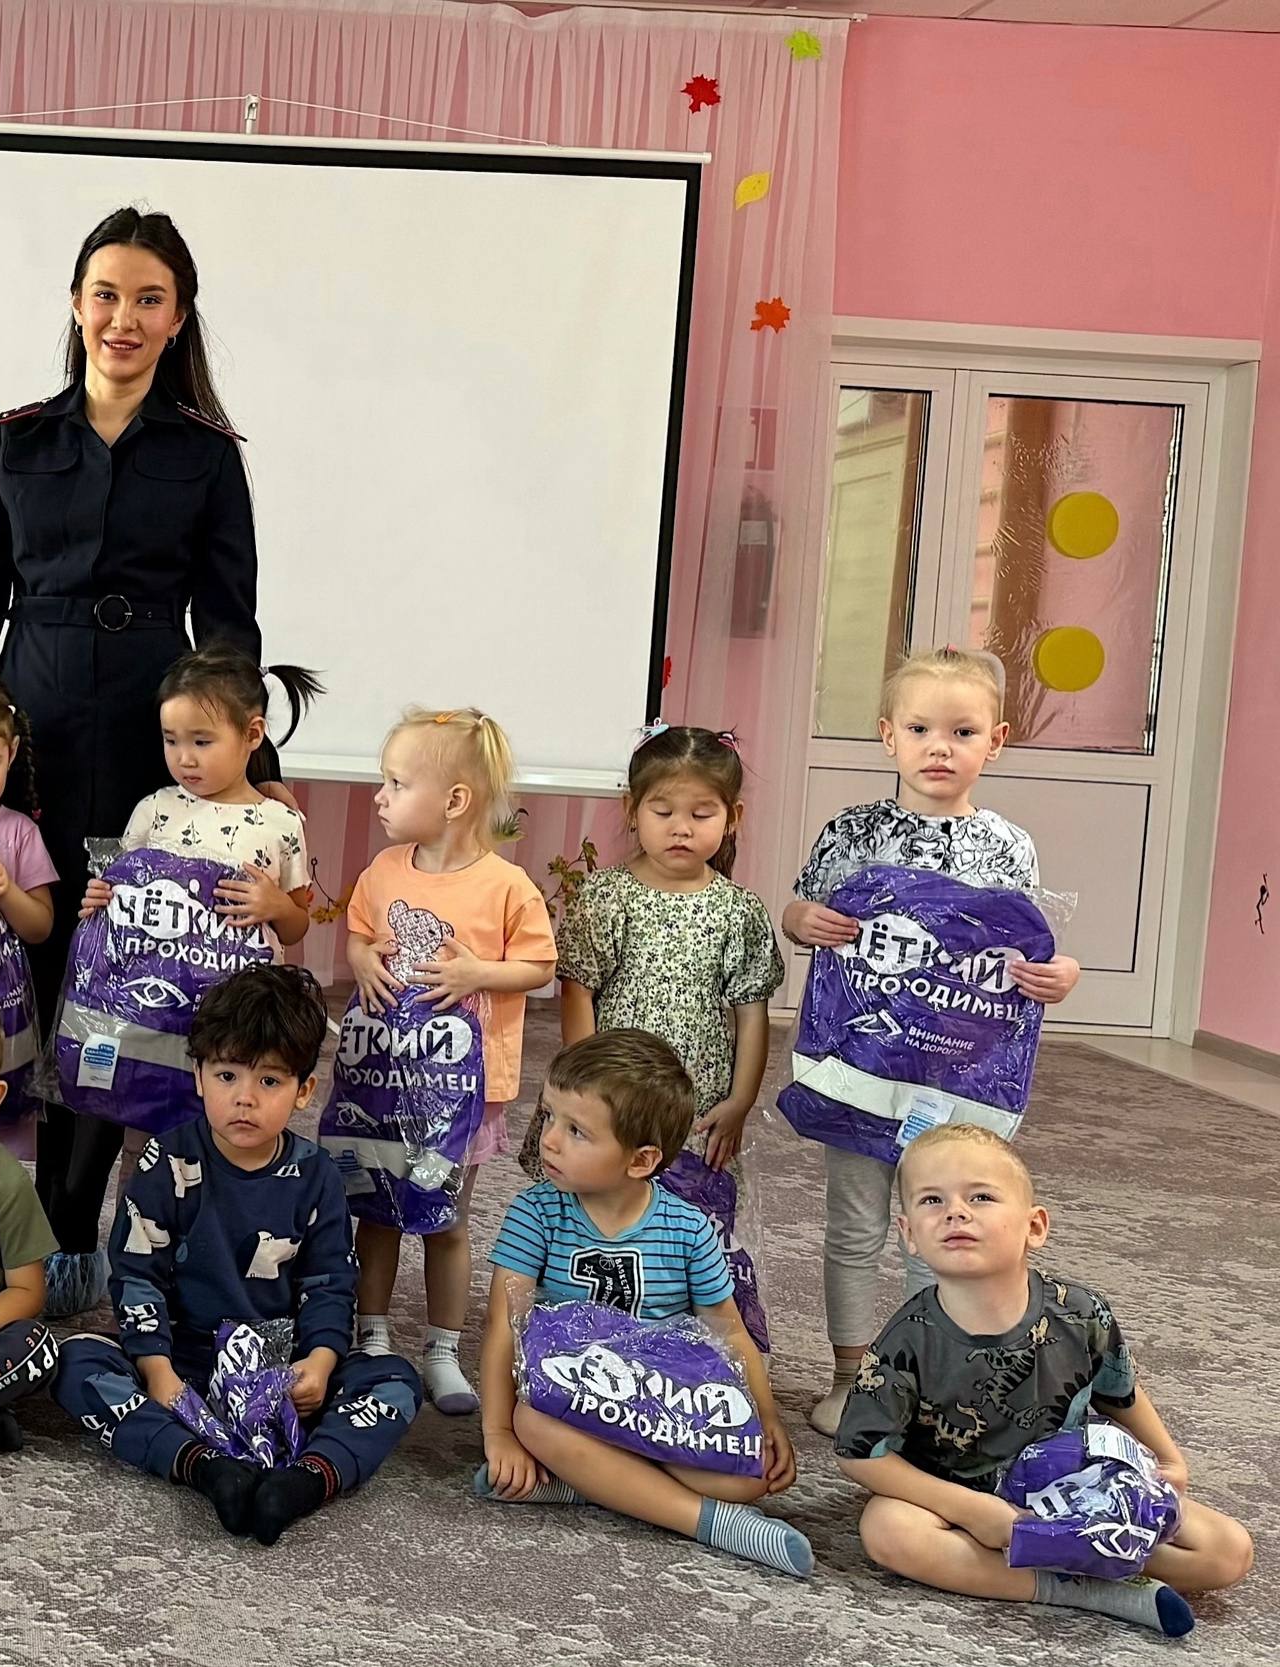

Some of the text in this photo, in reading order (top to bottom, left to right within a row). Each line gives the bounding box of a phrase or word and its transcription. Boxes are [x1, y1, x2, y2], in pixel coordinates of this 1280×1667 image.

[338, 1018, 454, 1060] ЁТКИЙ
[905, 1037, 920, 1048] НА
[909, 1026, 975, 1050] ВНИМАНИЕ
[615, 1257, 632, 1307] BASKETBALL
